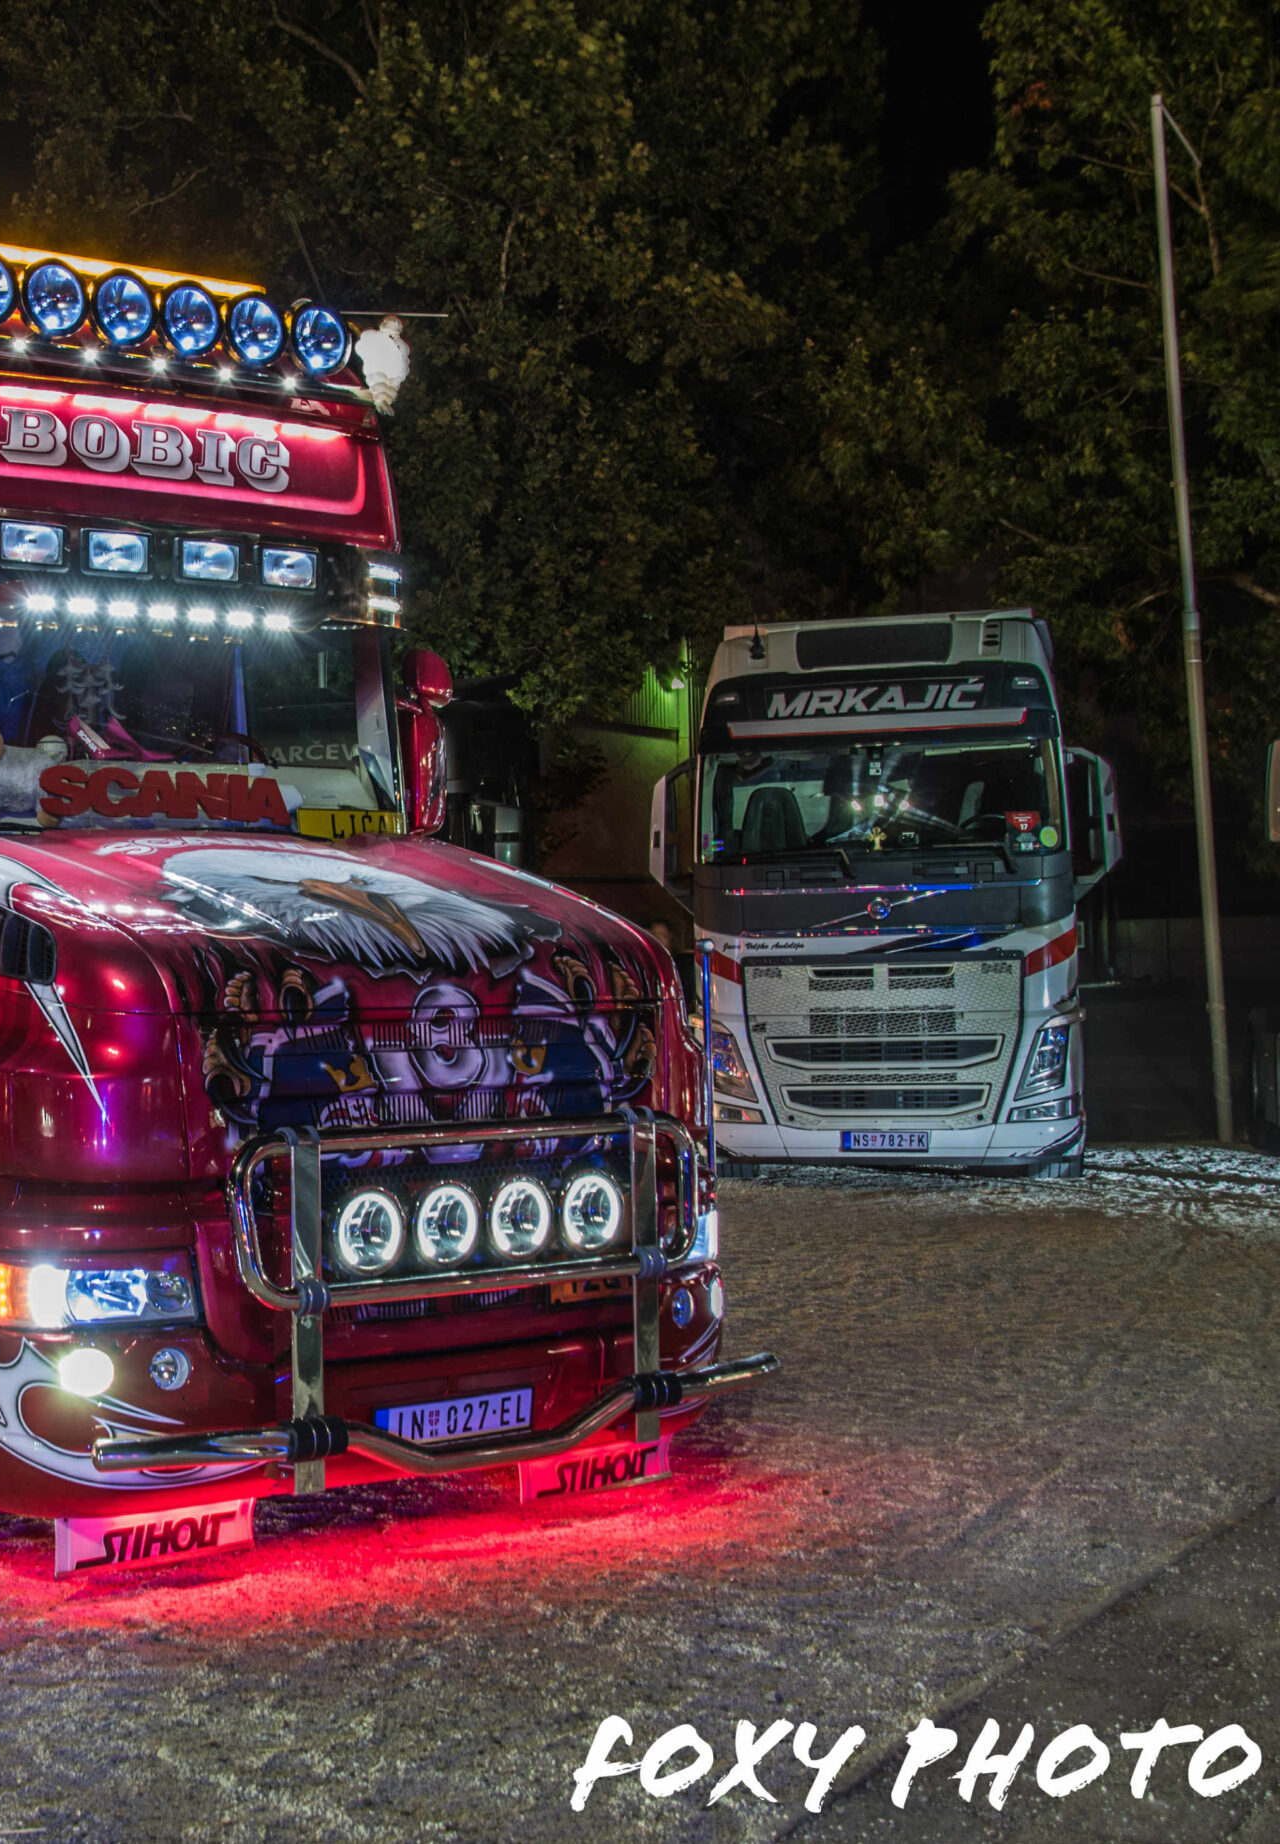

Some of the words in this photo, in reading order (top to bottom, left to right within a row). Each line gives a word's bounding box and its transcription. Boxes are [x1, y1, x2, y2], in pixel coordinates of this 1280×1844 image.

[767, 676, 984, 719] MRKAJIĆ
[39, 765, 292, 825] SCANIA
[853, 1134, 869, 1147] NS
[399, 1410, 424, 1440] IN
